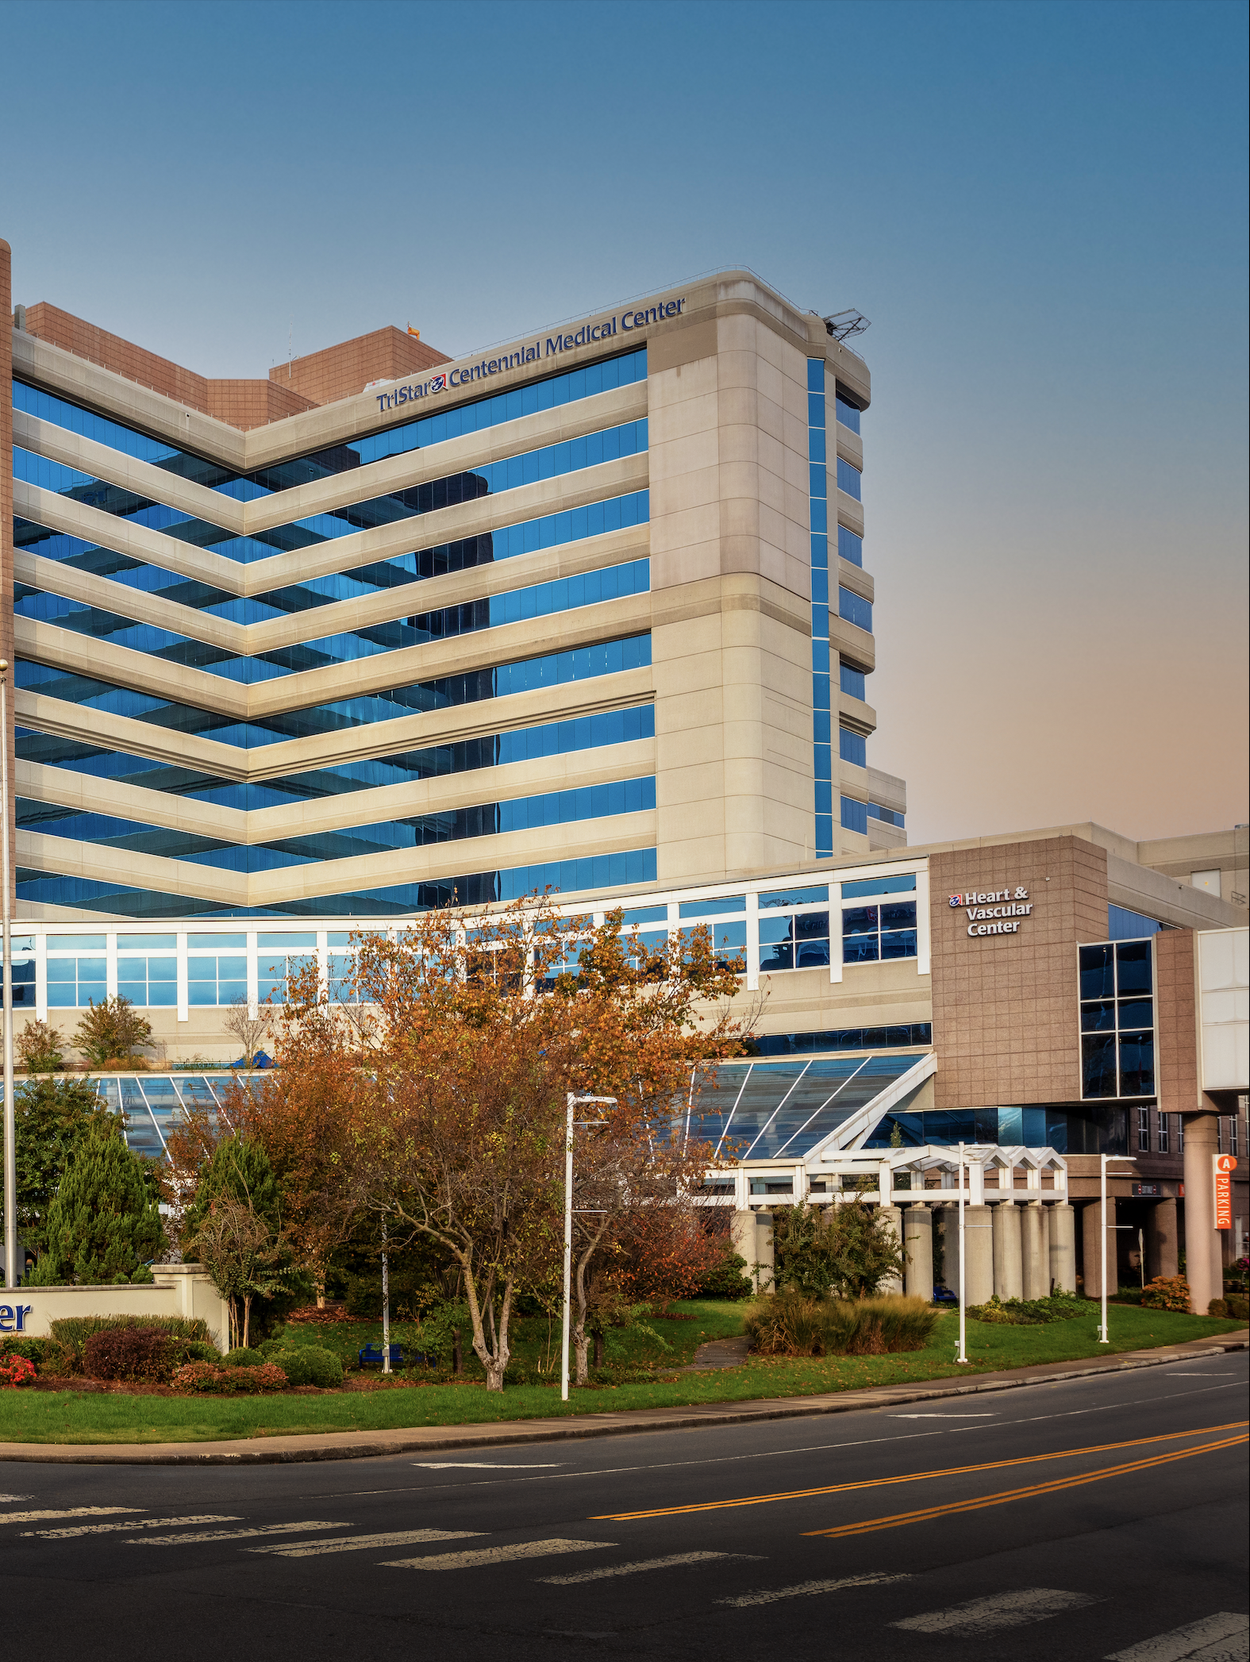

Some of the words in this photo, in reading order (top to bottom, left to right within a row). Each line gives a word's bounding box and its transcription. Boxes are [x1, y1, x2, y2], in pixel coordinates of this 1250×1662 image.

[376, 380, 432, 412] TriStar
[449, 341, 541, 387] Centennial
[546, 316, 617, 356] Medical
[621, 298, 686, 331] Center
[965, 888, 1010, 905] Heart
[1014, 886, 1029, 900] &
[966, 903, 1034, 921] Vascular
[967, 921, 1020, 937] Center
[1222, 1158, 1231, 1169] A
[1217, 1178, 1230, 1225] PARKING
